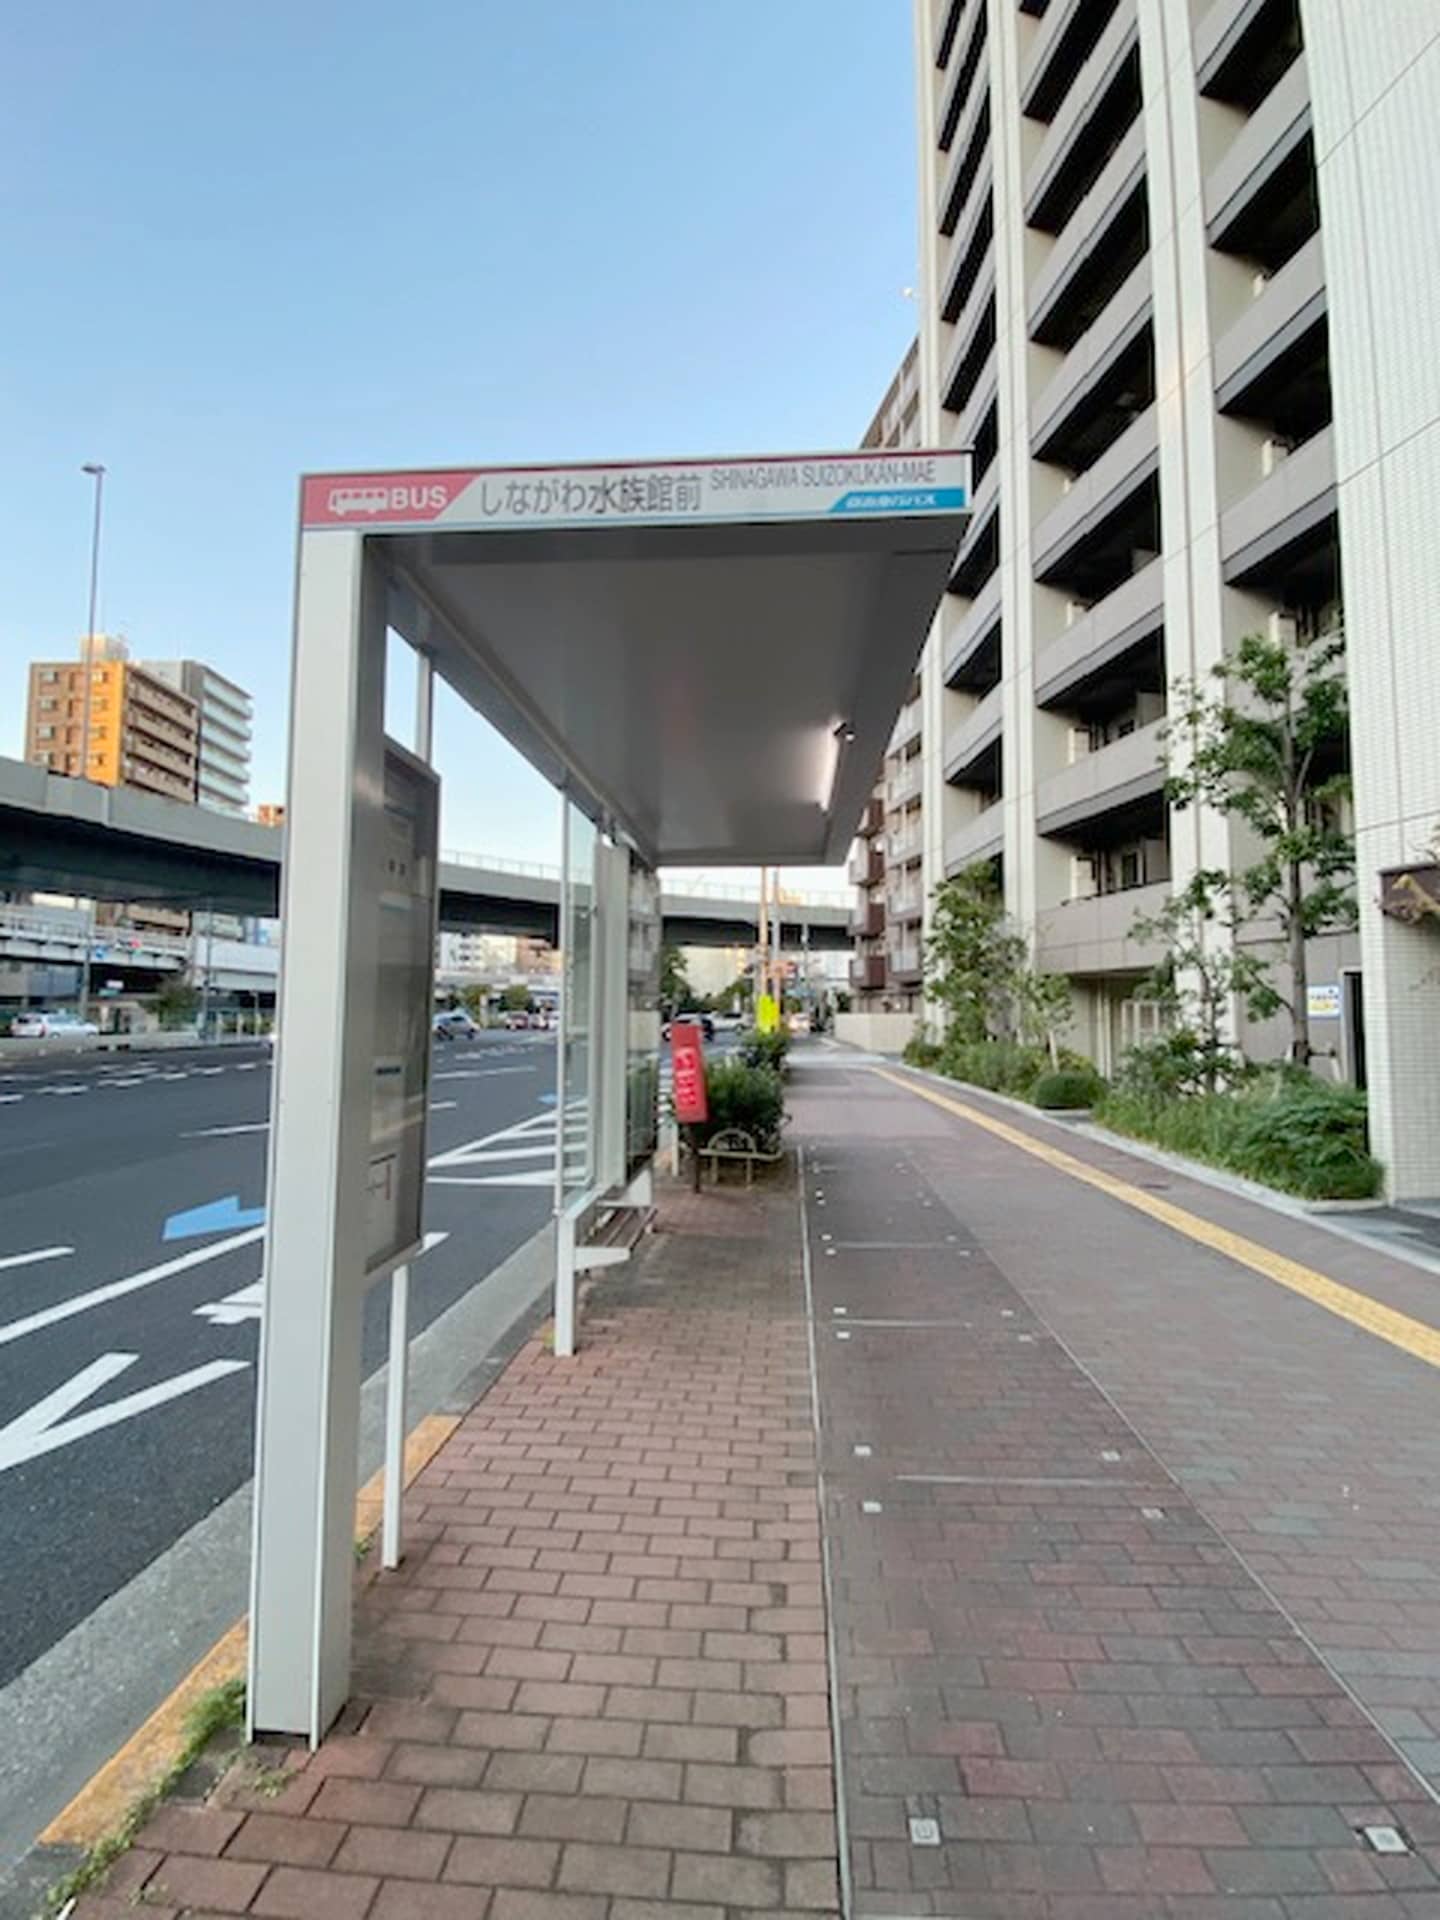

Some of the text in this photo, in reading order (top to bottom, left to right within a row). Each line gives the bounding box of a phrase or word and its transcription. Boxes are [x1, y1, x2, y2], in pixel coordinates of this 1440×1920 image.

[710, 465, 798, 490] SHINAGAWA
[391, 485, 448, 510] BUS
[481, 473, 702, 516] しながわ水族館前
